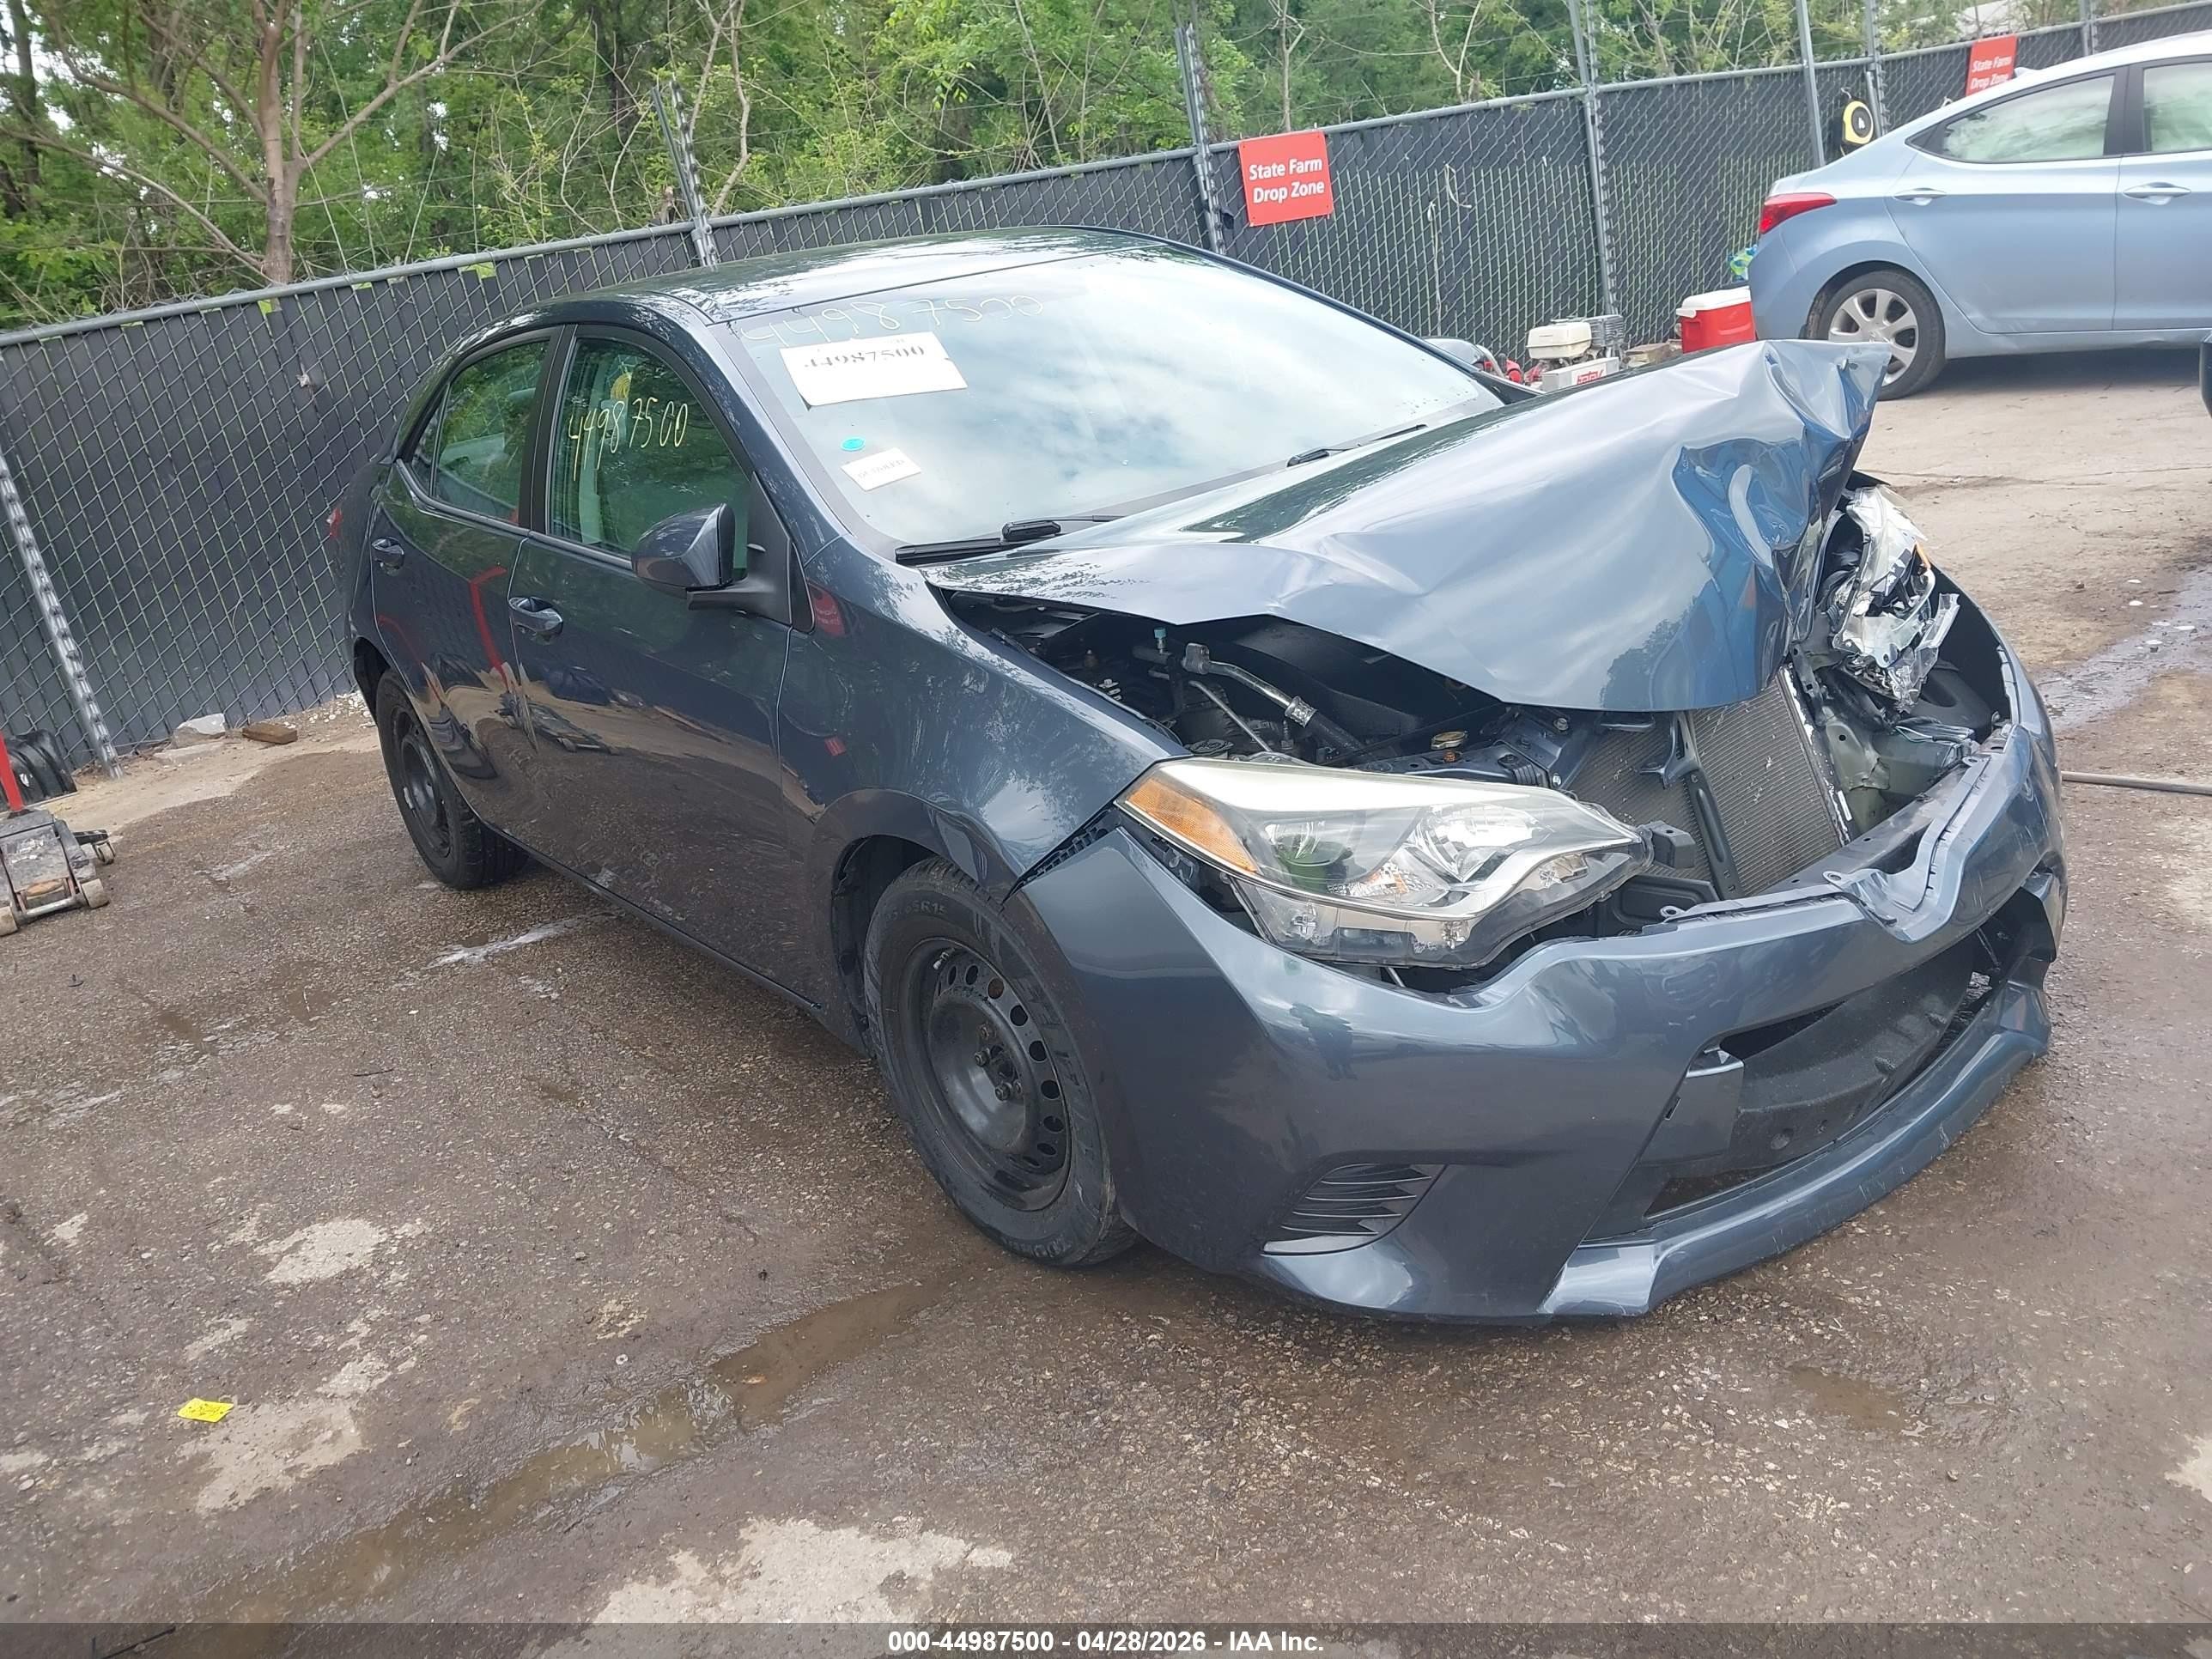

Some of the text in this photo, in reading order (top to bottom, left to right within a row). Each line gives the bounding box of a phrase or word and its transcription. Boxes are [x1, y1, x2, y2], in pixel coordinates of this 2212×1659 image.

[1972, 58, 1992, 72] State
[1249, 158, 1323, 181] State Farm
[1253, 180, 1325, 204] Drop Zone
